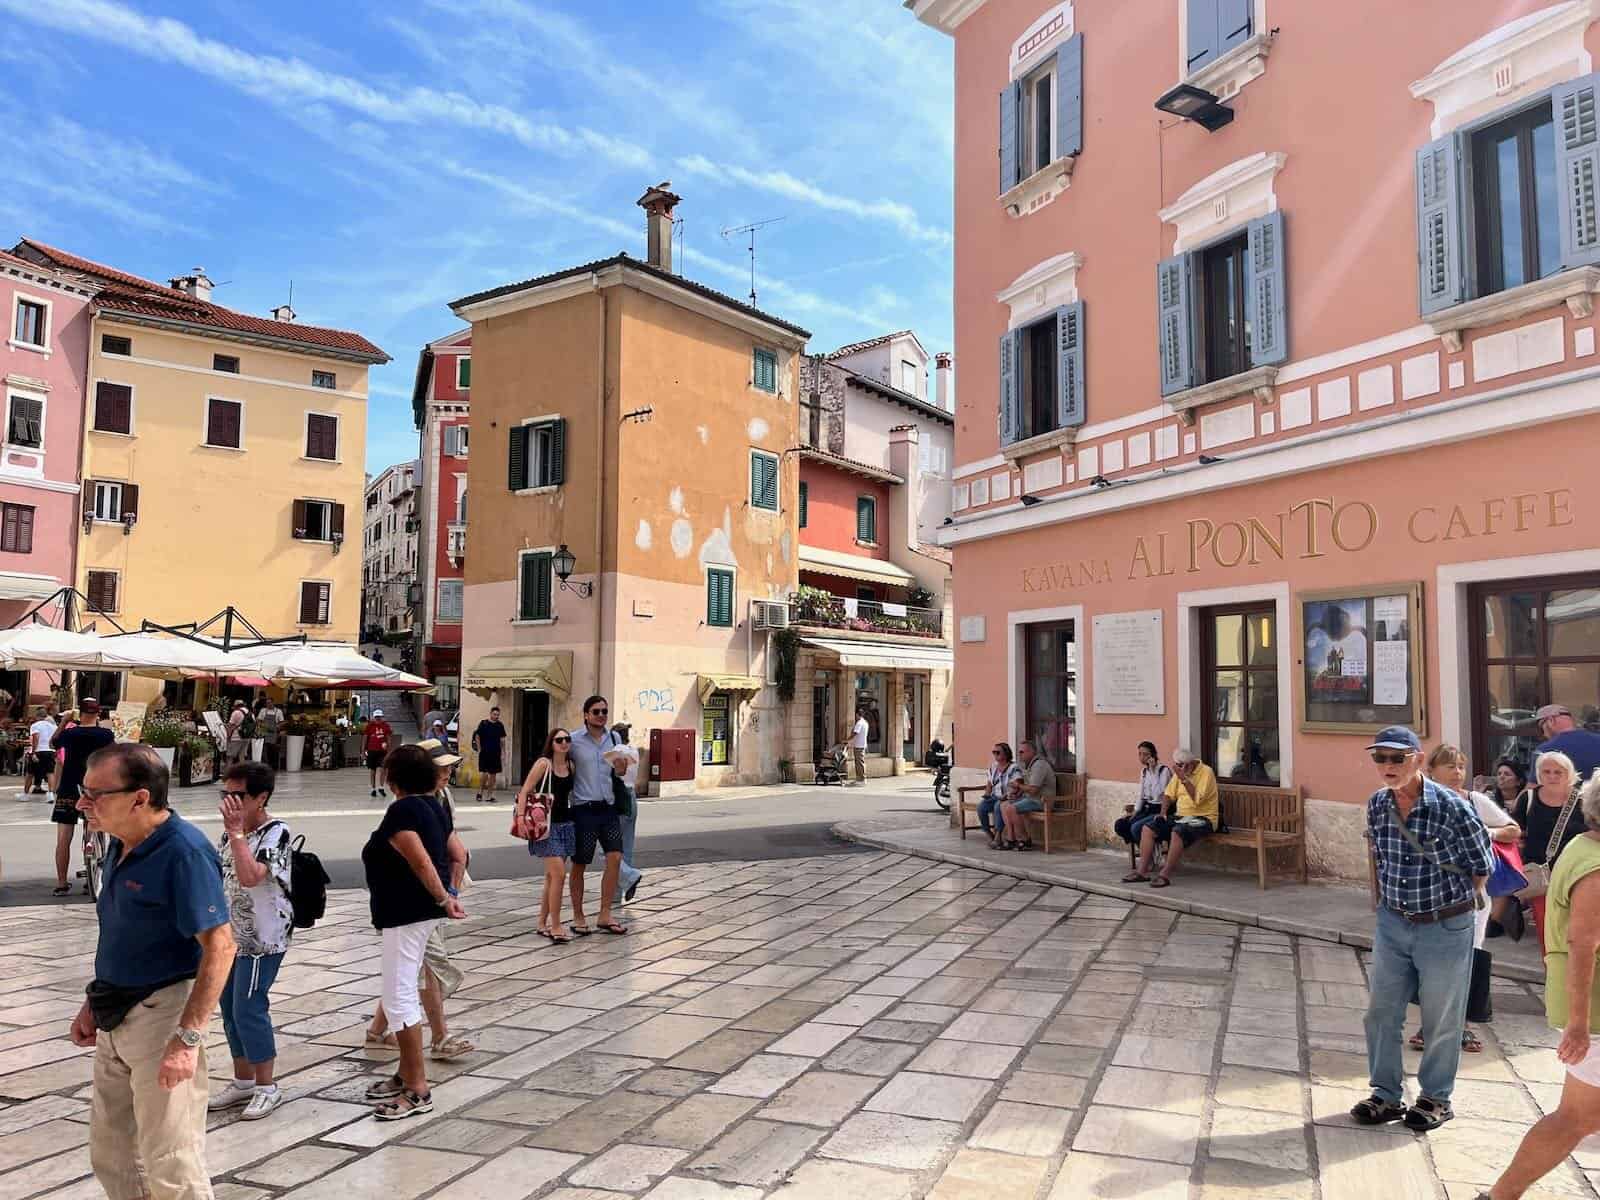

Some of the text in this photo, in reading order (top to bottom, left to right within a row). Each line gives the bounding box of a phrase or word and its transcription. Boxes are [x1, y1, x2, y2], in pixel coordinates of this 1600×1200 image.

[1023, 488, 1574, 593] KAVANA AL PONTO CAFFE
